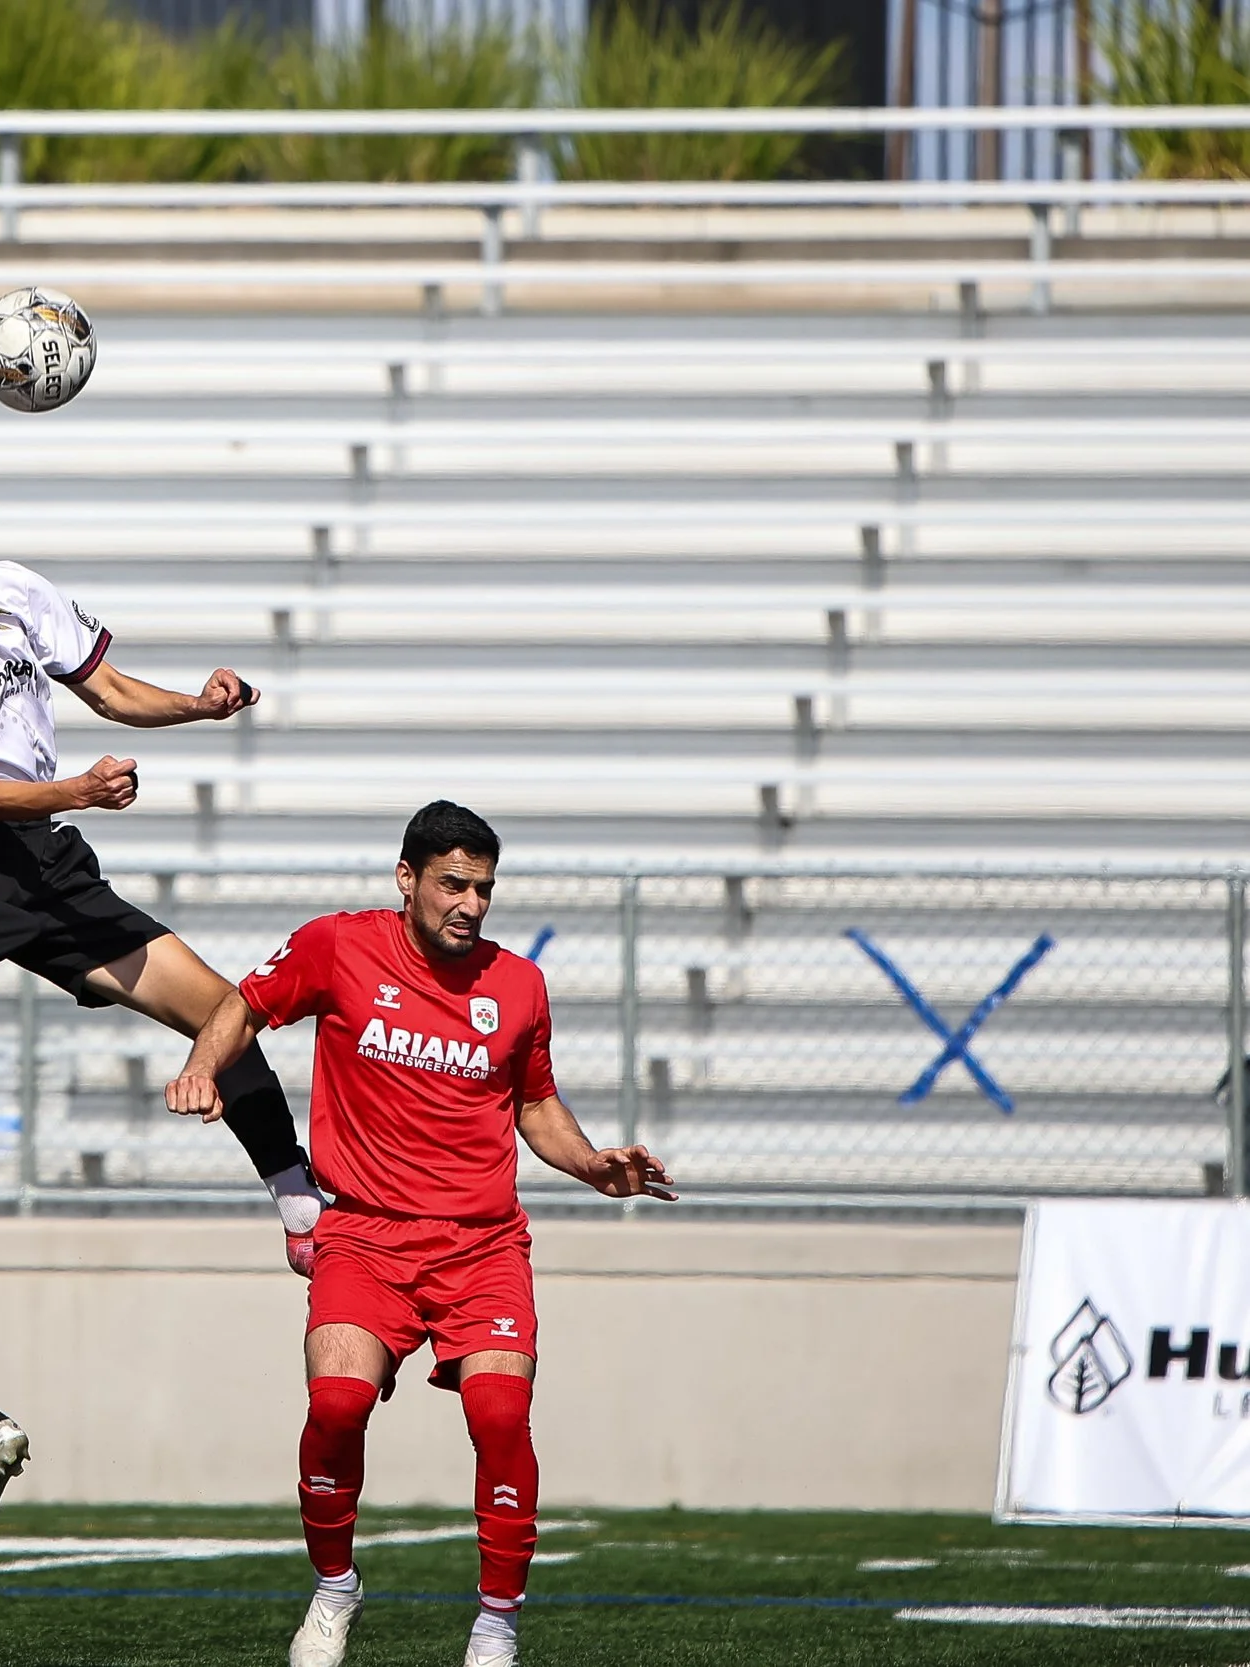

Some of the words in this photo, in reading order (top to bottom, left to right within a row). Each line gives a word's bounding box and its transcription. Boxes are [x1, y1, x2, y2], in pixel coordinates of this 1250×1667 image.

[42, 340, 62, 400] SELECT
[357, 1045, 489, 1080] ARIANASWEETS.COM
[358, 1017, 490, 1072] ARIANA
